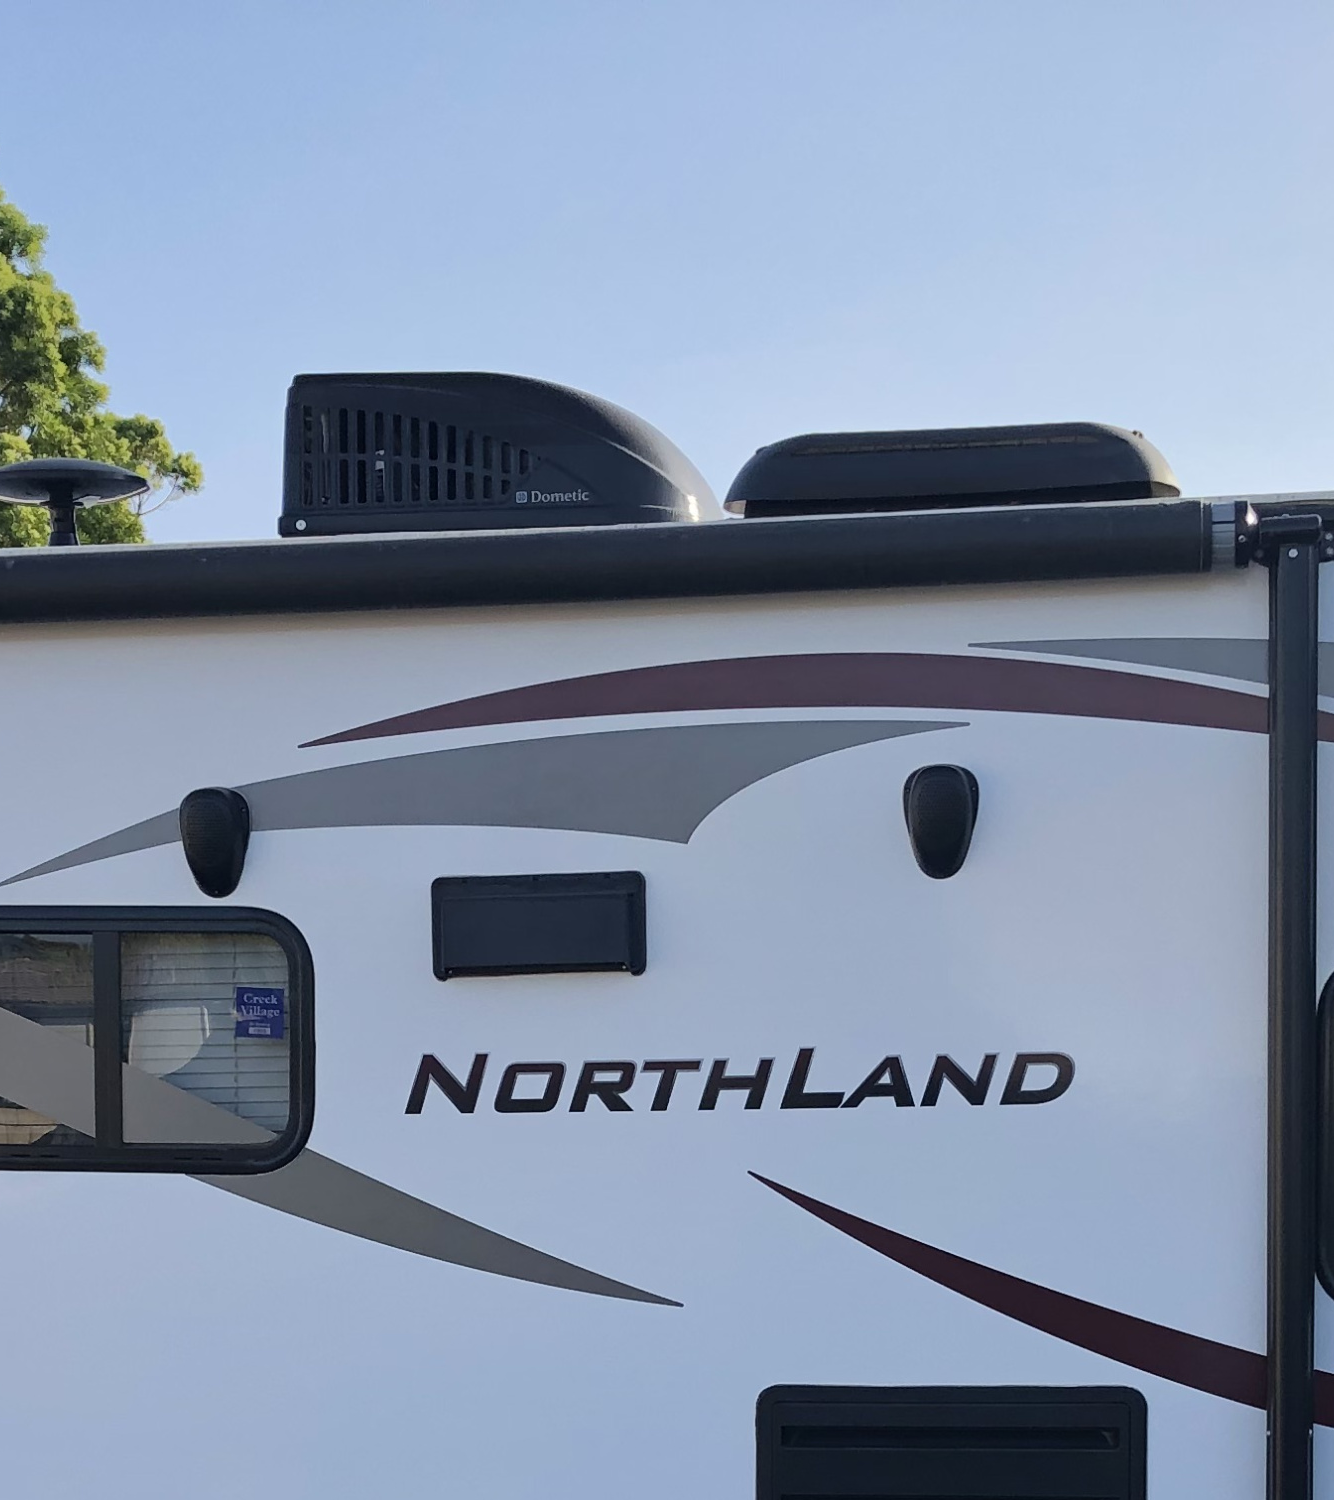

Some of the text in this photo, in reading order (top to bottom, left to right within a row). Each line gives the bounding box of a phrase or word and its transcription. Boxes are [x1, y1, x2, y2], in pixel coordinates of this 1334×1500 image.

[530, 488, 590, 503] Dometic
[242, 993, 278, 1005] Creek
[240, 1004, 280, 1019] Village
